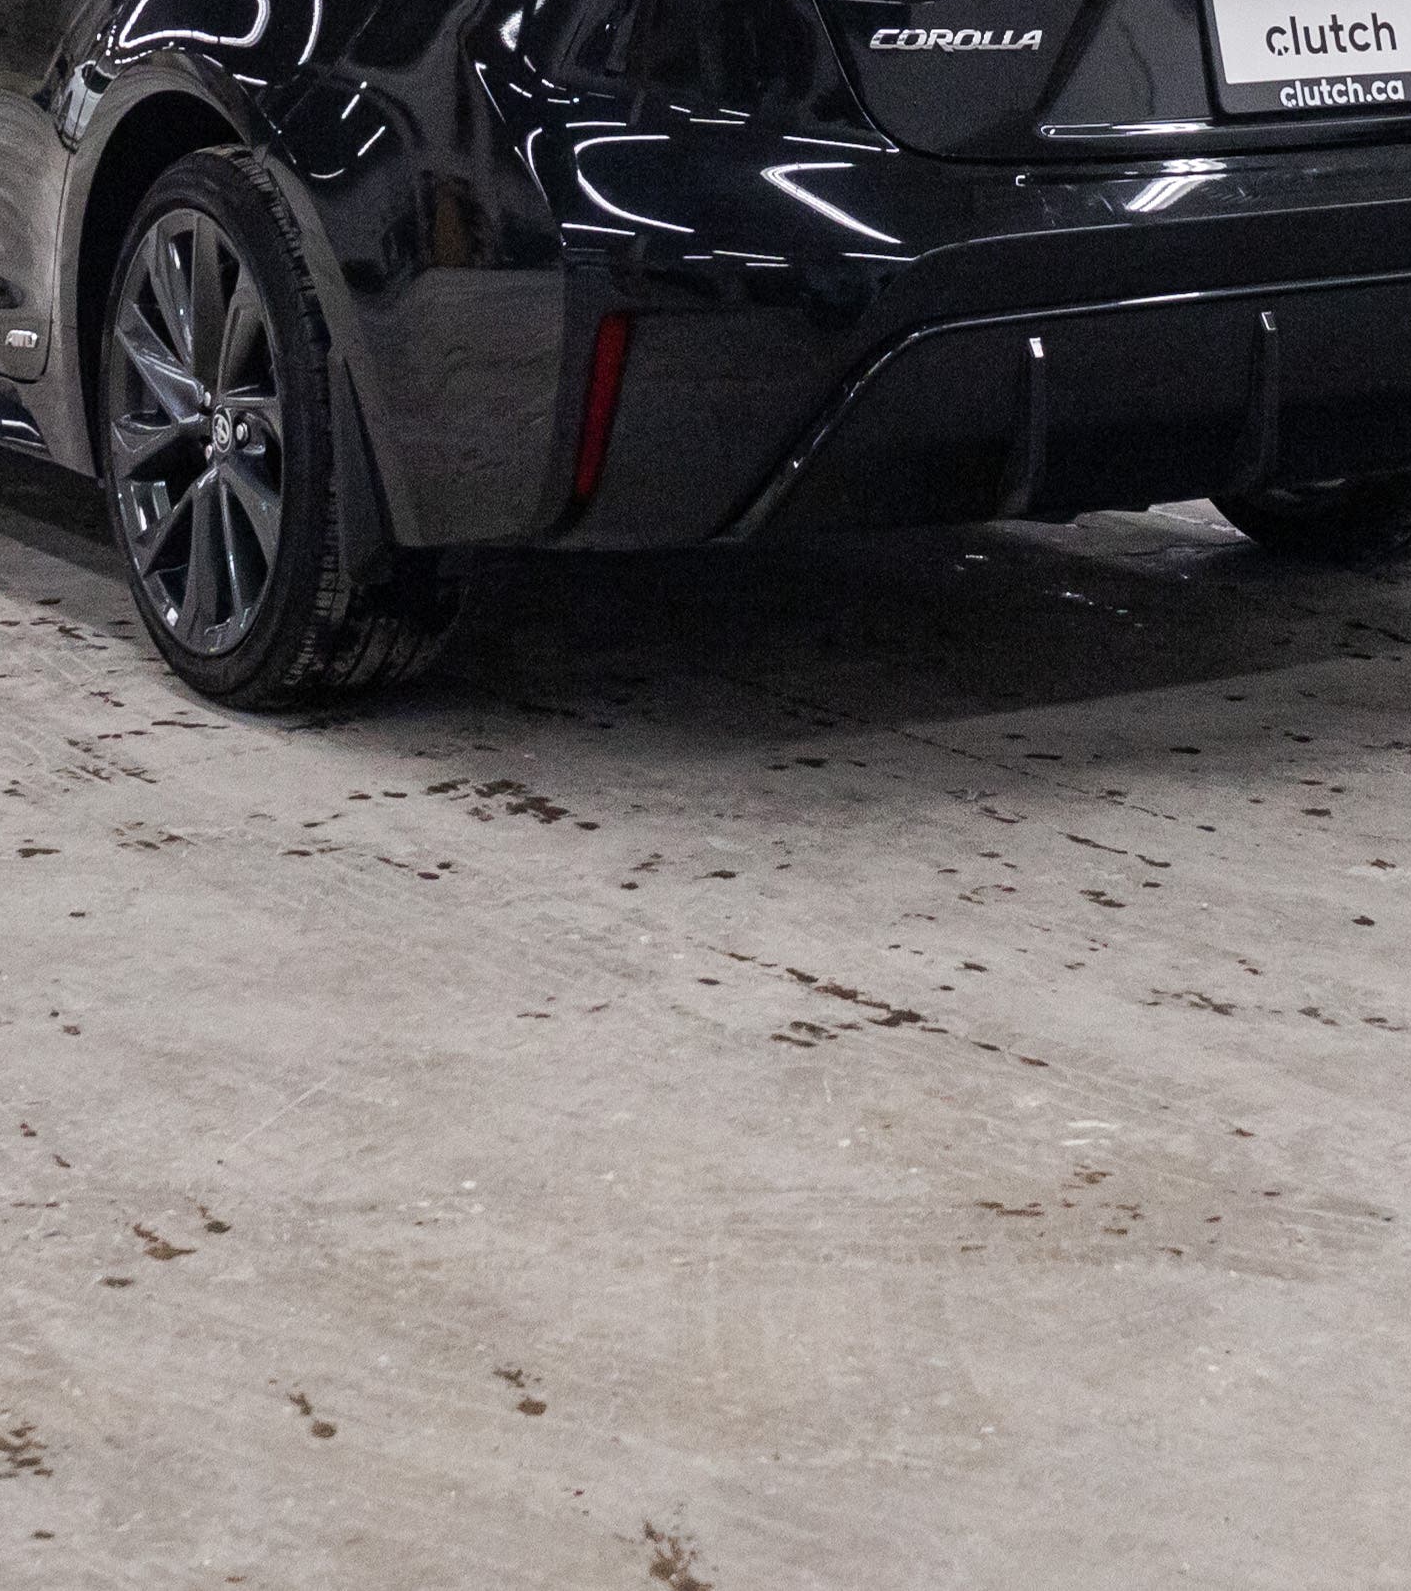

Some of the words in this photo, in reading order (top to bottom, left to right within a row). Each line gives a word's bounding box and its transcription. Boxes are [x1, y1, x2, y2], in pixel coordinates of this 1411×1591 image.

[870, 28, 1043, 52] COROLLA
[1265, 12, 1397, 56] clutch
[1279, 77, 1404, 108] clutch.ca
